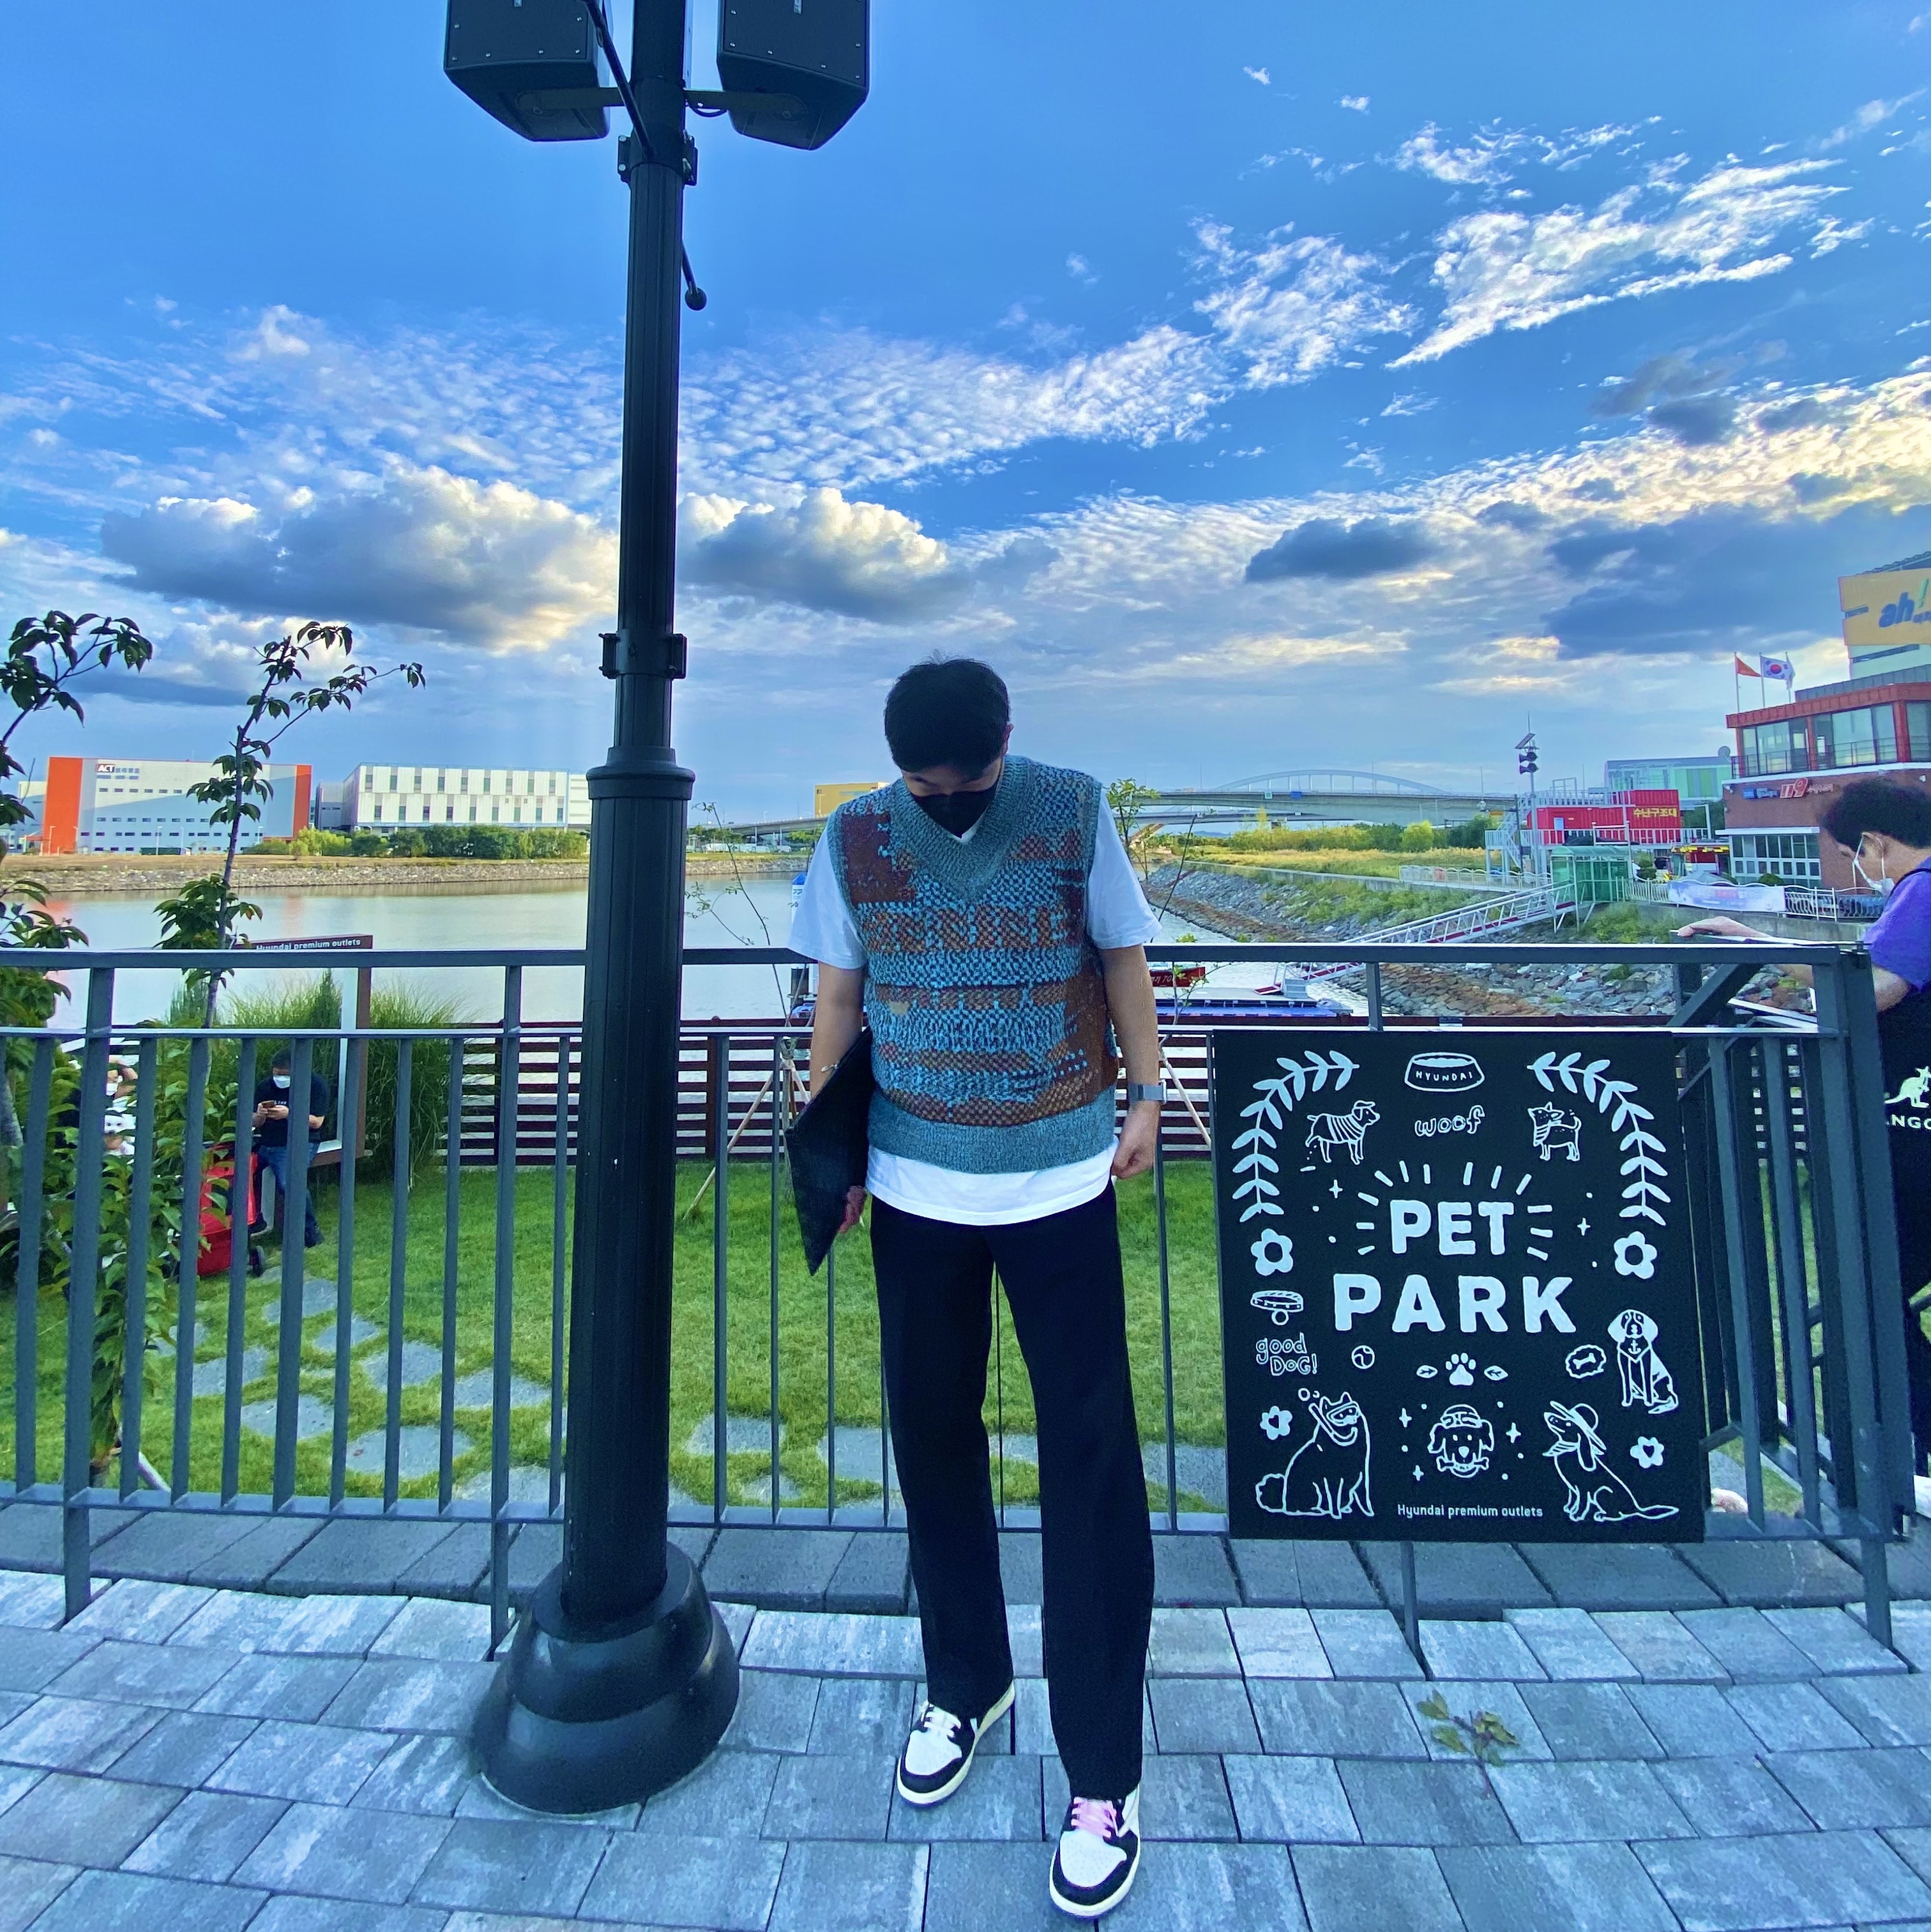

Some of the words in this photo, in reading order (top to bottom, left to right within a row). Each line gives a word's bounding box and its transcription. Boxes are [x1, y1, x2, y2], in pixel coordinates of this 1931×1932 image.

[1780, 777, 1808, 798] 119
[1633, 807, 1677, 818] 수난구조대
[294, 941, 329, 950] premium
[332, 938, 361, 947] outlets
[1416, 1070, 1473, 1081] HYUNDAI
[1414, 1104, 1486, 1137] woof
[1390, 1199, 1515, 1256] PET
[1333, 1273, 1577, 1333] PARK
[1255, 1332, 1308, 1365] good
[1397, 1504, 1445, 1519] Hyundai
[1448, 1505, 1499, 1519] premium
[1501, 1505, 1543, 1517] outlets
